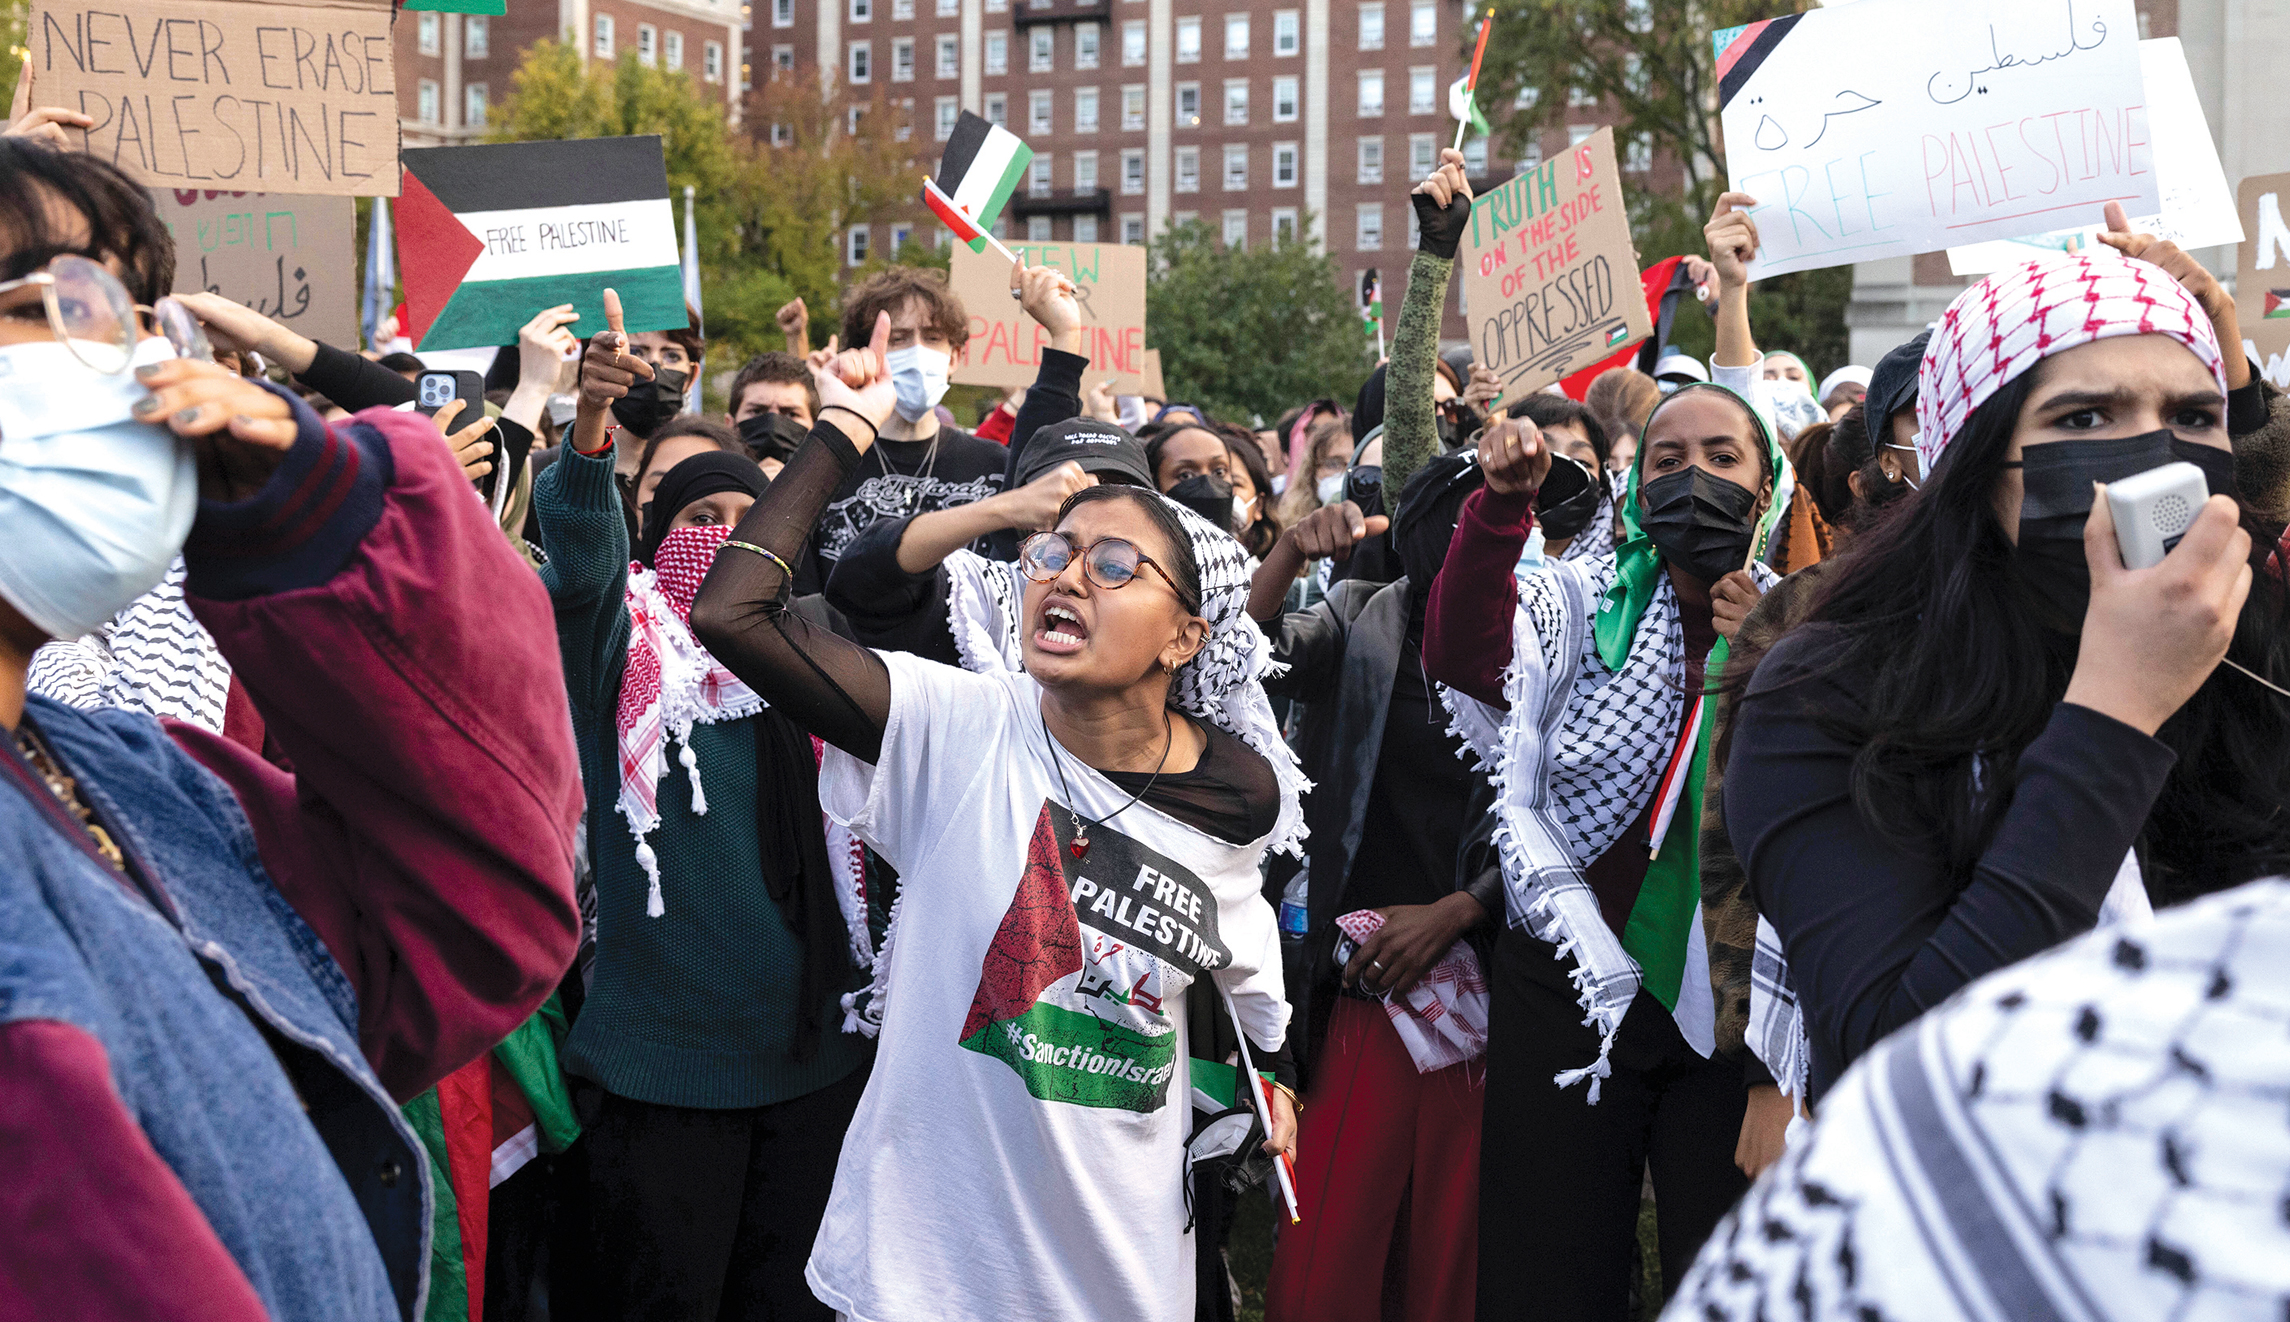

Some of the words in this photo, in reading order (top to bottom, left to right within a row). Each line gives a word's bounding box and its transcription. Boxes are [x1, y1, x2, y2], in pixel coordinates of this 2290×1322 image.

[43, 11, 231, 85] NEVER
[256, 27, 394, 95] ERASE
[1928, 0, 2107, 104] فلسطين
[79, 90, 377, 181] PALESTINE
[1750, 90, 1882, 151] حرة
[1470, 160, 1557, 248] TRUTH
[1574, 146, 1594, 186] IS
[1740, 150, 1895, 261] FREE
[1922, 106, 2148, 217] PALESTINE
[487, 225, 527, 255] FREE
[539, 219, 630, 250] PALESTINE
[1479, 241, 1507, 277] ON
[1517, 211, 1555, 254] THE
[1559, 184, 1603, 234] SIDE
[1500, 264, 1525, 299] OF
[1531, 233, 1580, 281] THE
[963, 315, 1142, 374] PALEINE
[1483, 255, 1612, 370] OPPRESSED
[1071, 875, 1222, 970] PALESTINE
[1132, 863, 1202, 925] FREE
[1006, 1021, 1176, 1085] #SanctionIsrael
